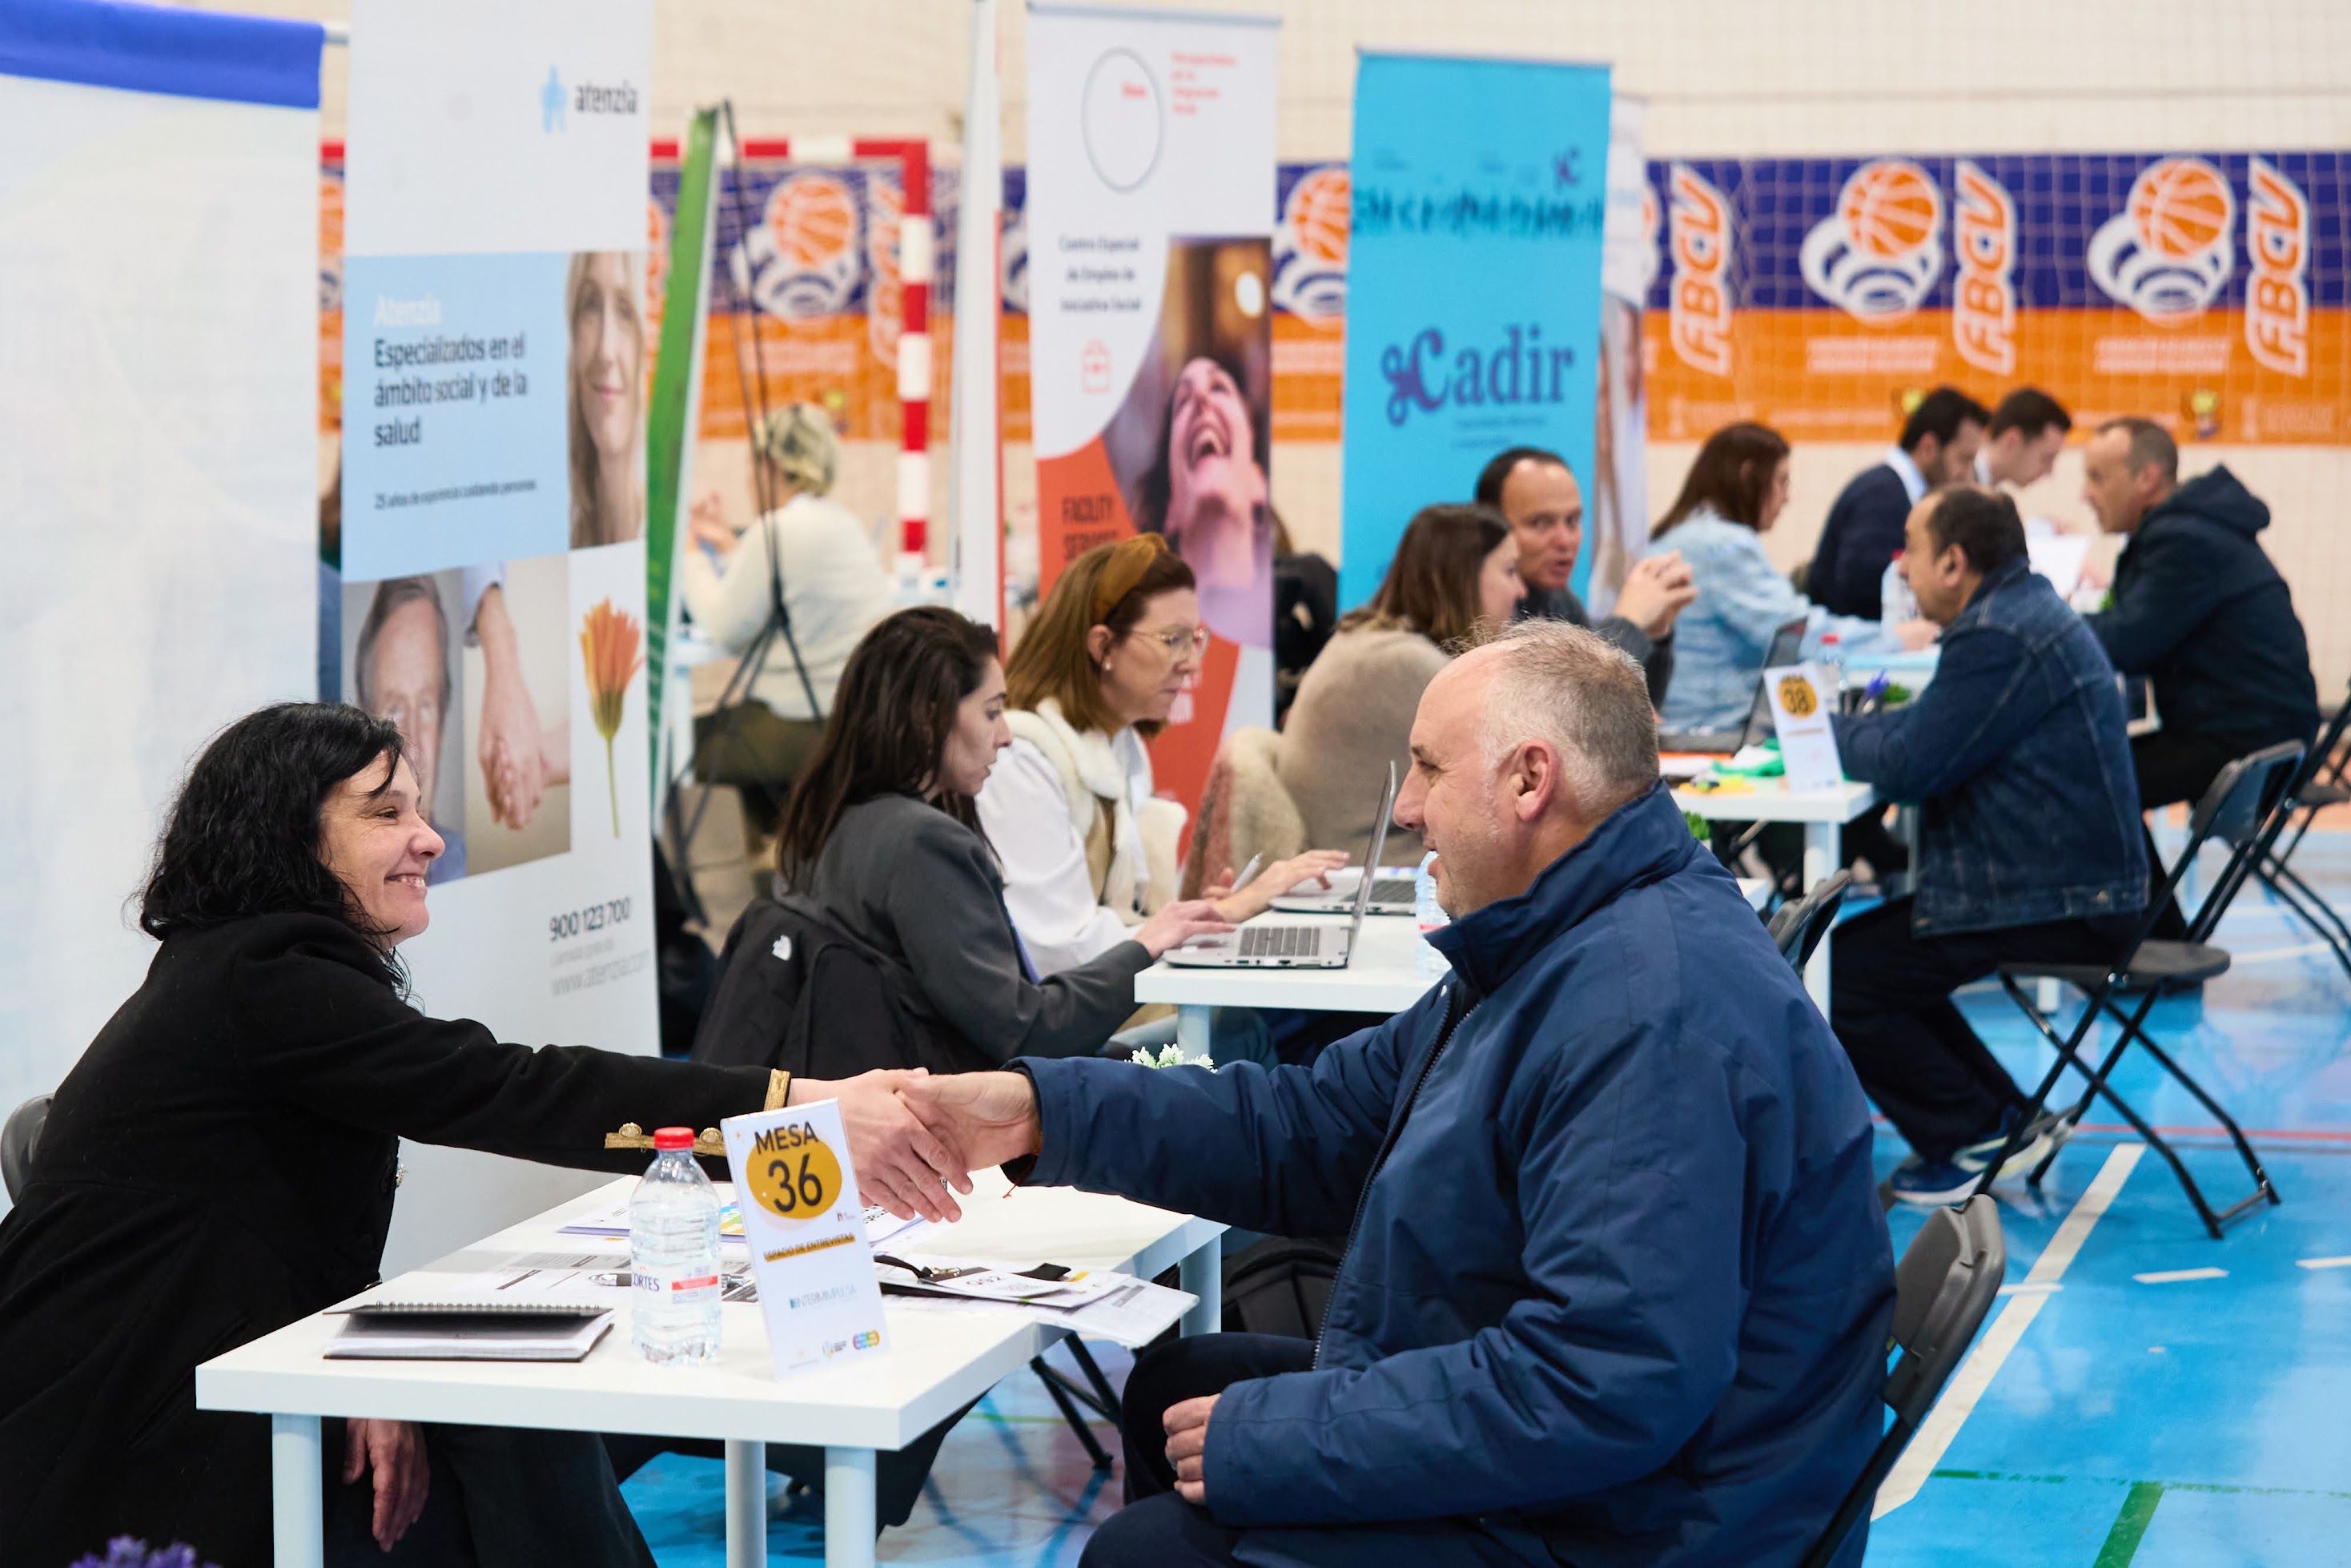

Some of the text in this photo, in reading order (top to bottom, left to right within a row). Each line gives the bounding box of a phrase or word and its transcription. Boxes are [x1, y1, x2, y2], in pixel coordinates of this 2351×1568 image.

[575, 78, 638, 114] atenzia
[373, 293, 442, 328] Atenzia
[374, 329, 525, 372] Especializados en el
[374, 368, 527, 408] ámbito social y de la
[1397, 324, 1575, 416] Cadir
[374, 414, 423, 448] salud
[550, 897, 630, 941] 900 123 700
[754, 1120, 819, 1155] MESA
[767, 1153, 823, 1213] 36
[633, 1272, 659, 1292] ORTES
